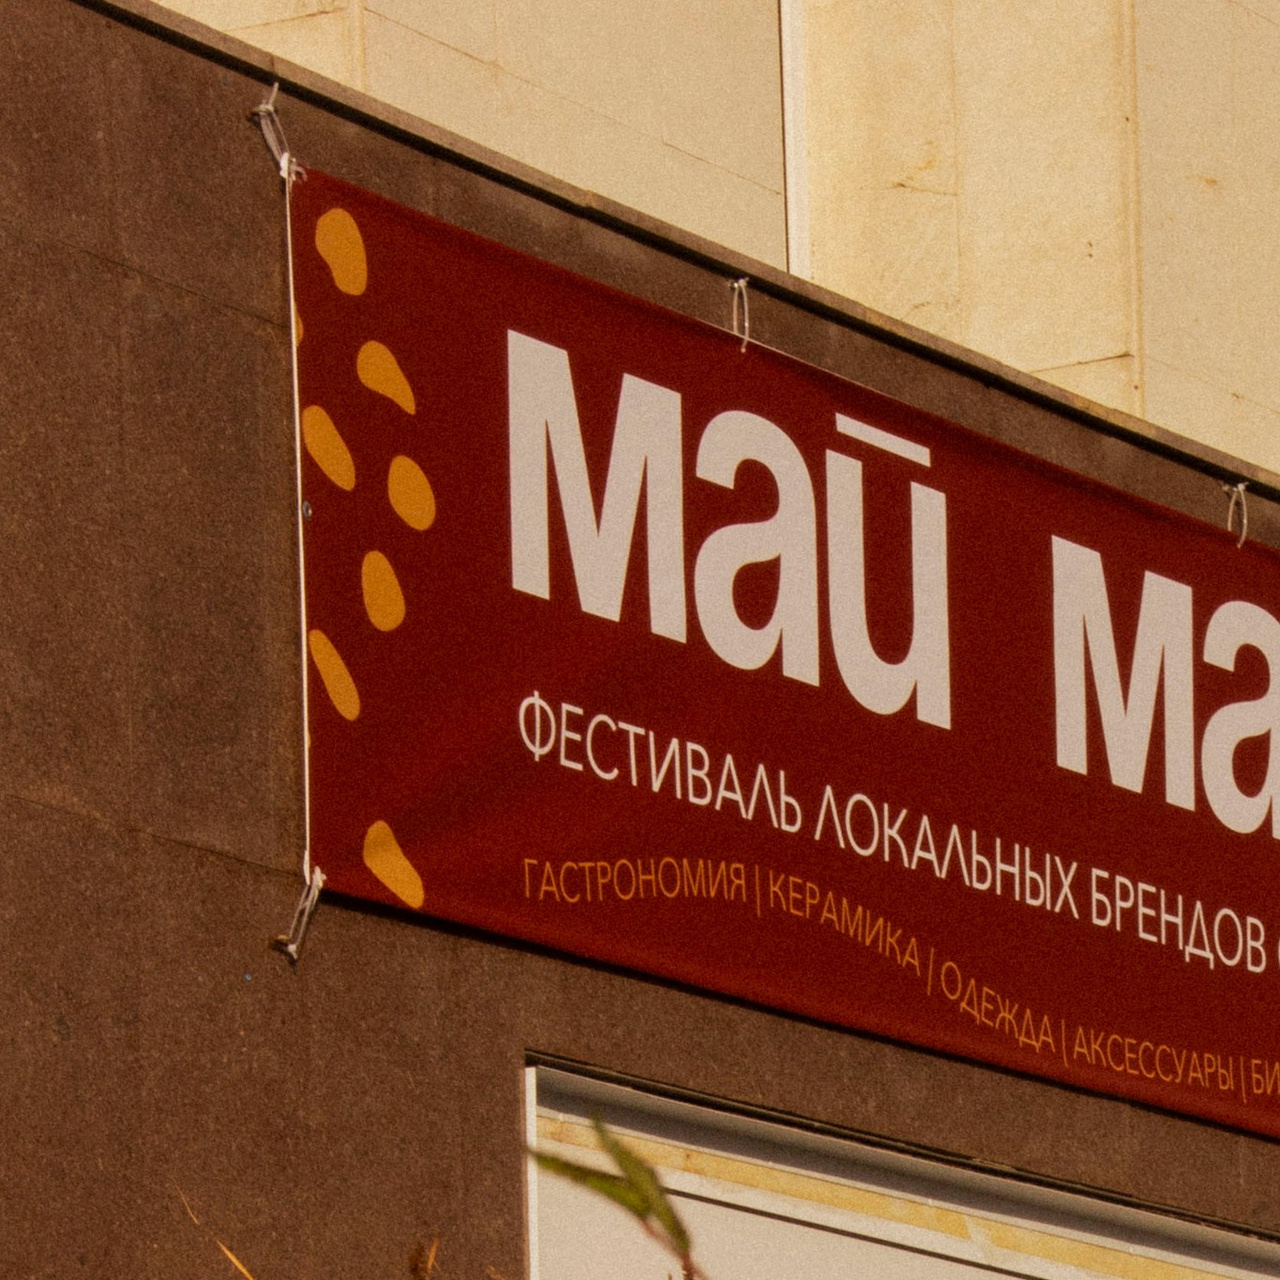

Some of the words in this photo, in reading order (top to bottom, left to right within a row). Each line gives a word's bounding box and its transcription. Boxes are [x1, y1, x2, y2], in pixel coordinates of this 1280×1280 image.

[507, 328, 952, 731] Май
[518, 689, 803, 834] ФЕСТИВАЛЬ
[813, 784, 1080, 920] ЛОКАЛЬНЫХ
[1090, 867, 1267, 974] БРЕНДОВ
[523, 856, 747, 903] ГАСТРОНОМИЯ
[769, 869, 921, 977] КЕРАМИКА
[940, 961, 1056, 1054] ОДЕЖДА
[1073, 1025, 1234, 1090] АКСЕССУАРЫ
